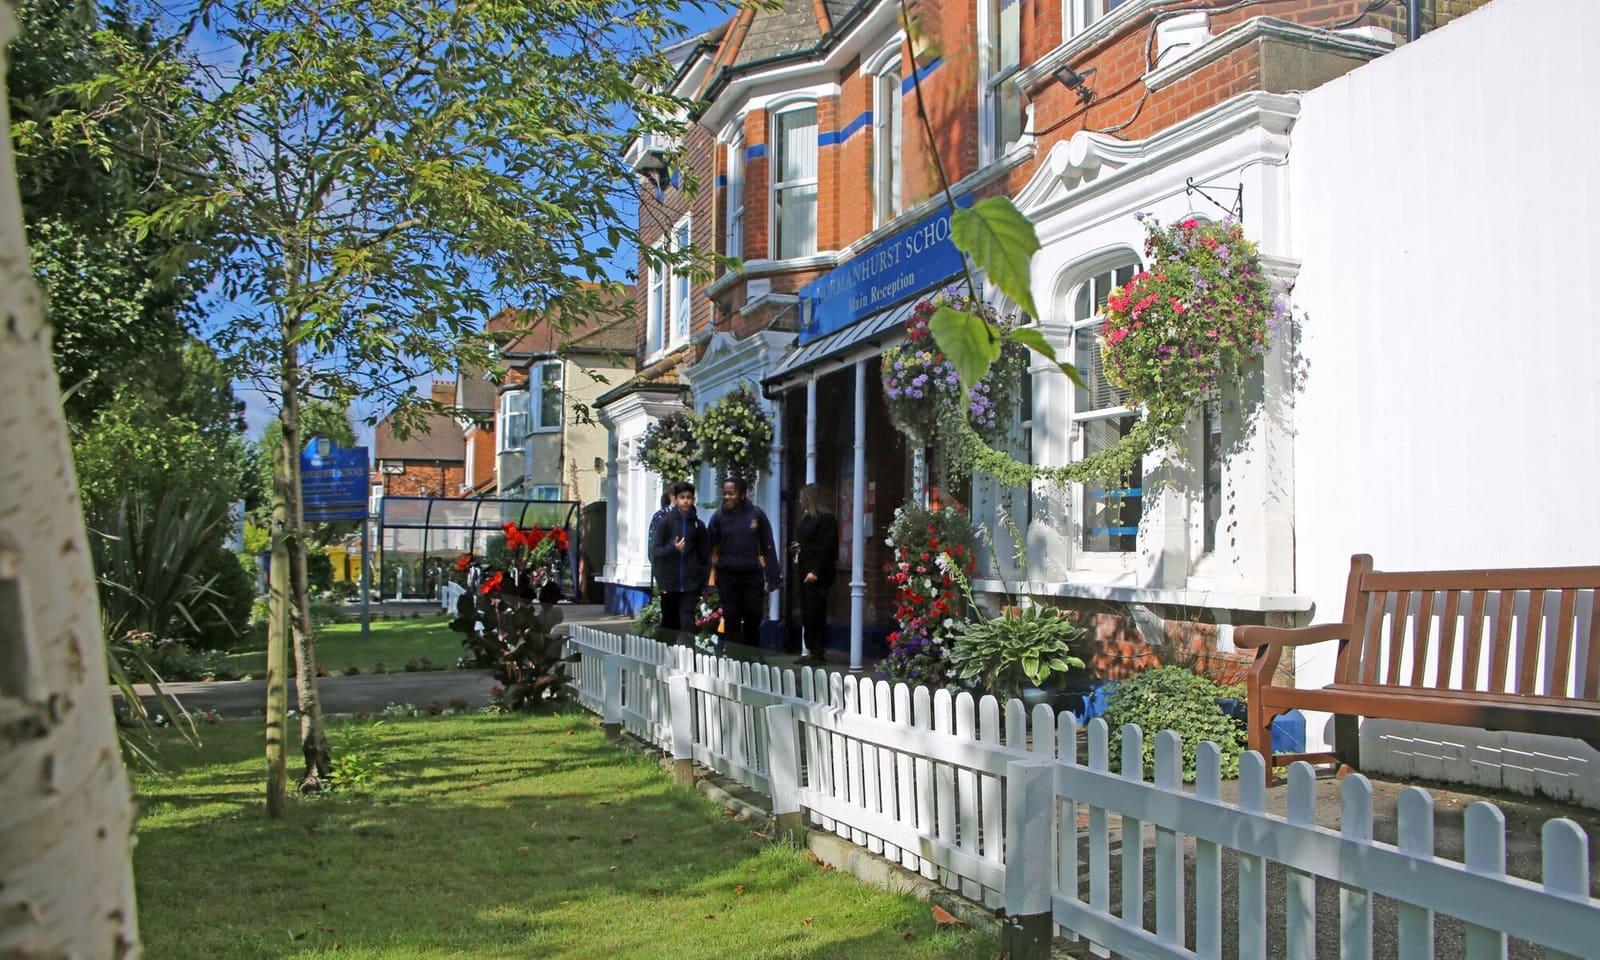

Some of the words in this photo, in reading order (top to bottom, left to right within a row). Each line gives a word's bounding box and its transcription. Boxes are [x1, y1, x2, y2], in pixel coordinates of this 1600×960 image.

[905, 216, 952, 257] SCHO
[848, 292, 868, 312] Main
[871, 272, 914, 302] Reception
